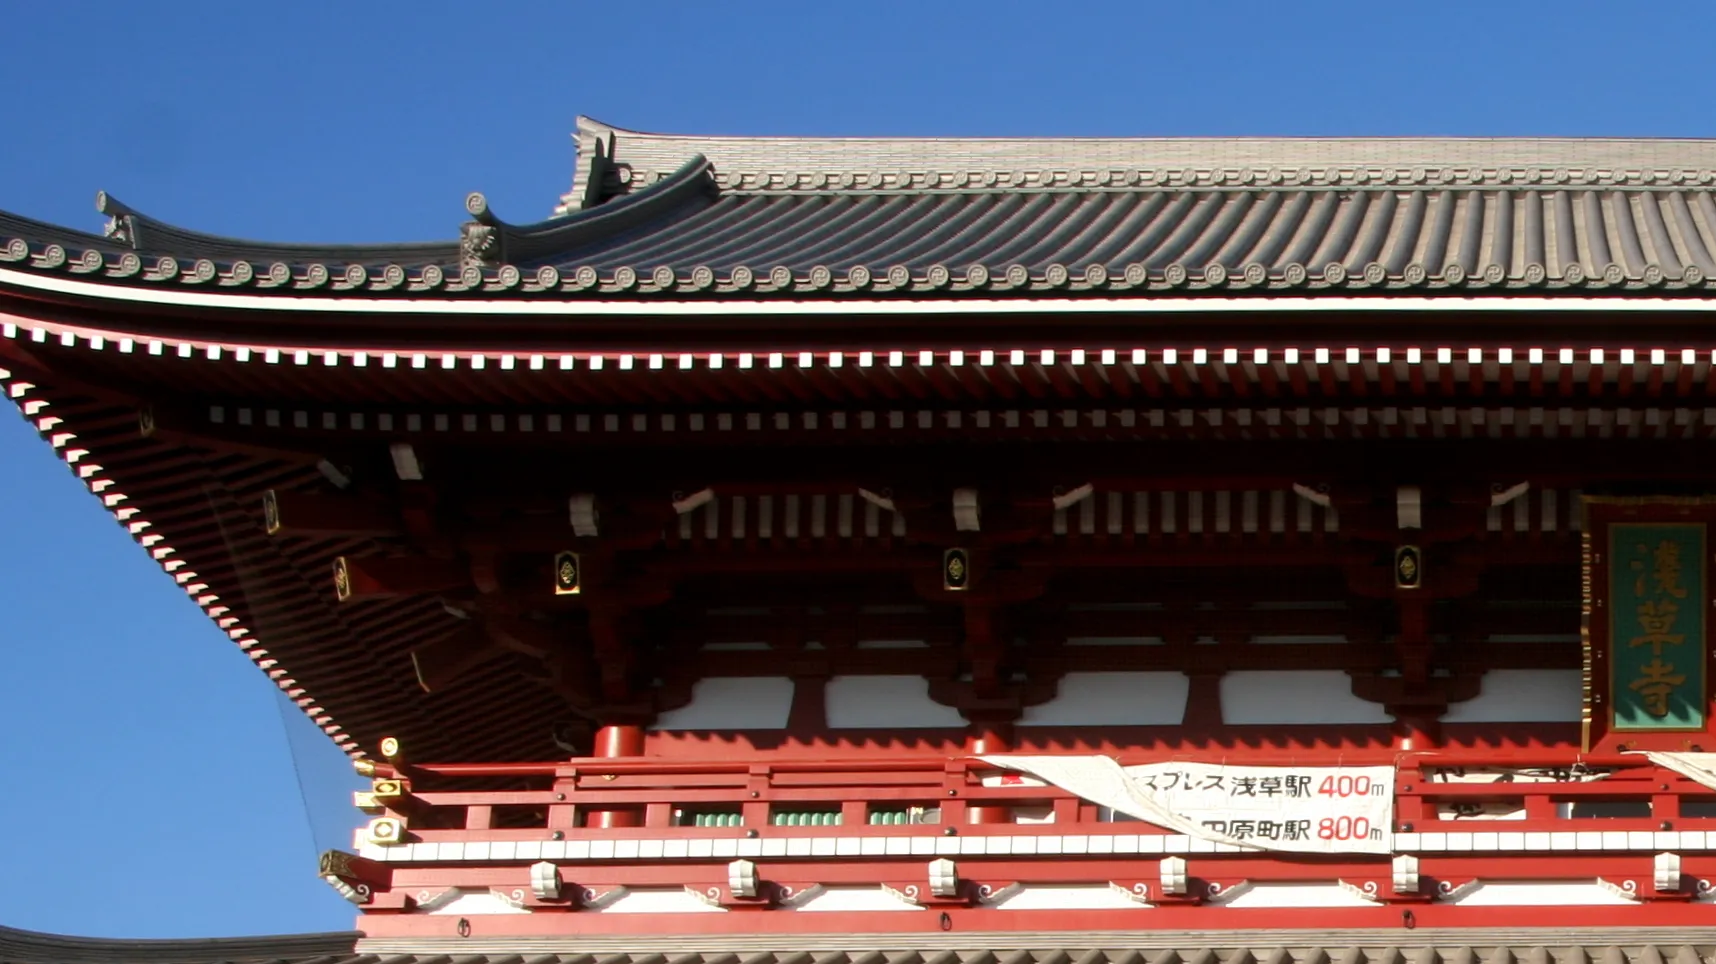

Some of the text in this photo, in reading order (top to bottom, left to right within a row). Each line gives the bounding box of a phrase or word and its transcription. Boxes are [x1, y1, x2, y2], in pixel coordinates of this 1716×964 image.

[1230, 775, 1312, 798] 浅草駅
[1317, 775, 1385, 798] 400m
[1317, 816, 1383, 841] 800m
